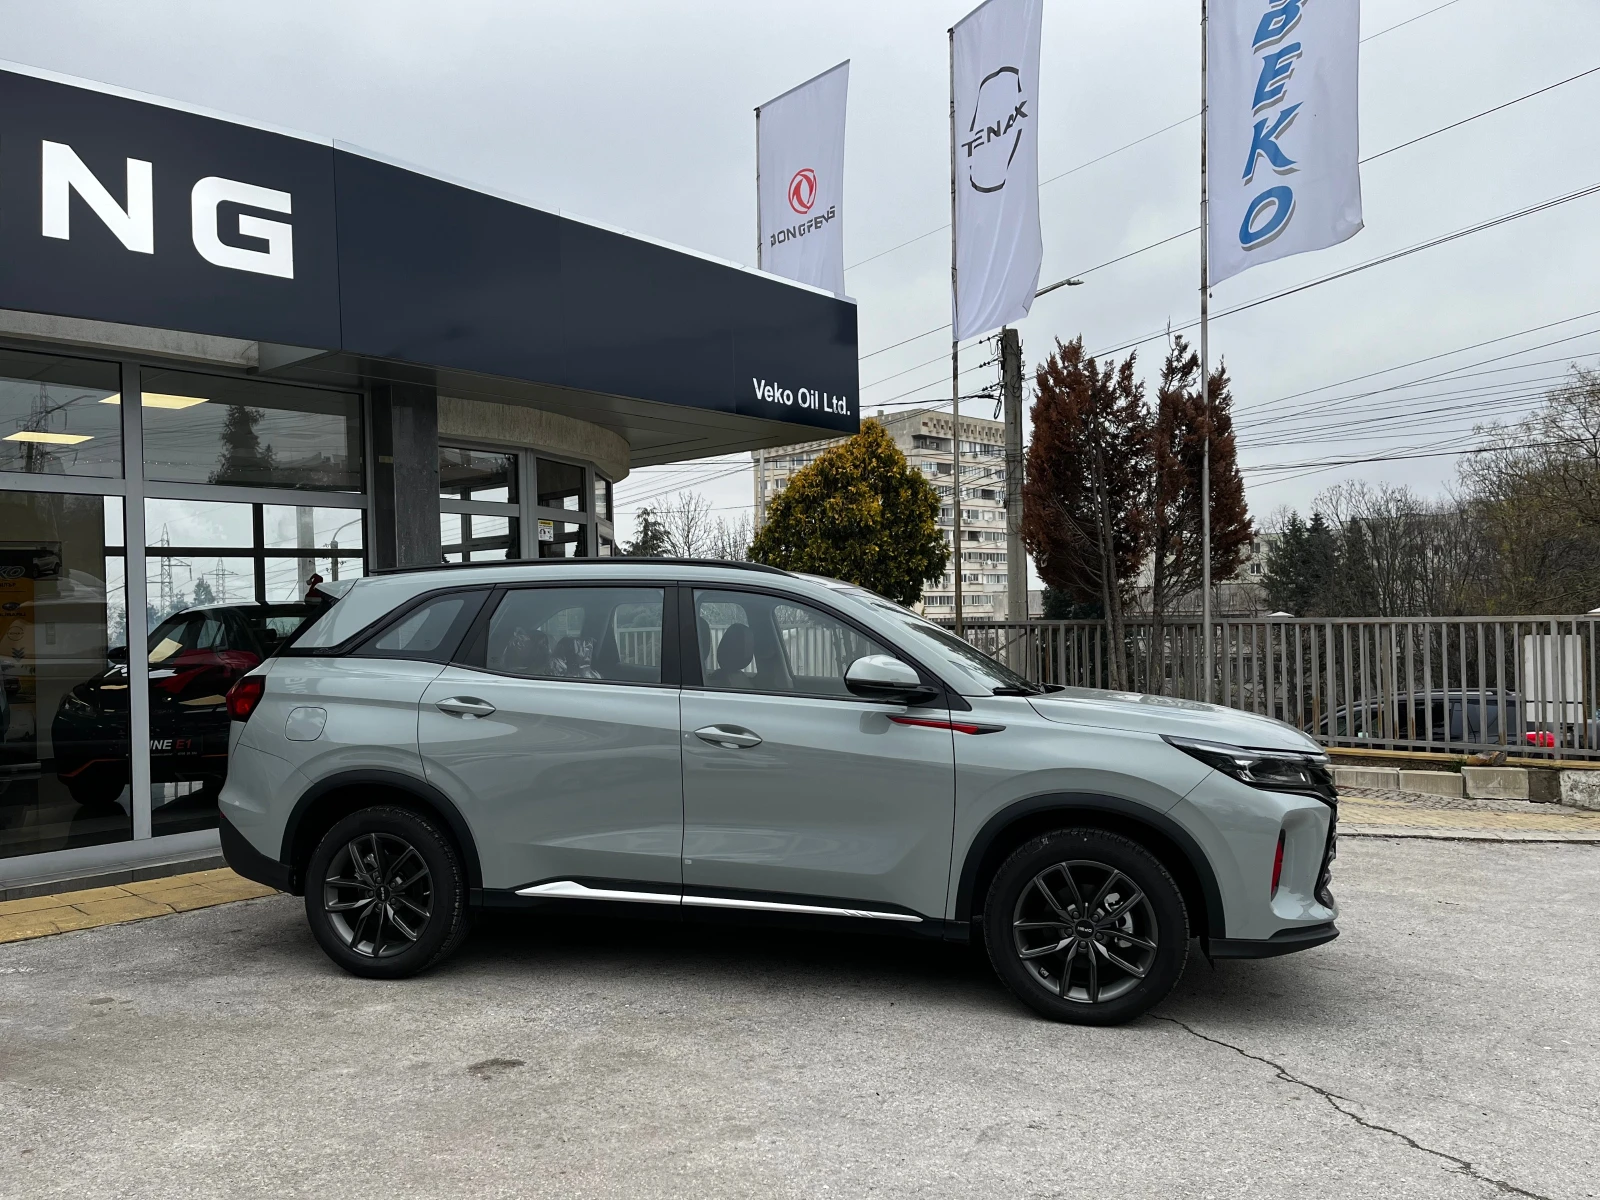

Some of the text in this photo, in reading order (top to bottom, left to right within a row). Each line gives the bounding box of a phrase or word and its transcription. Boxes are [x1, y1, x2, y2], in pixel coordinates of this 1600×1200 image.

[961, 99, 1029, 158] TENAX
[769, 205, 836, 248] DONGFENG
[752, 377, 851, 416] Veko Oil Ltd.
[175, 739, 192, 749] E1
